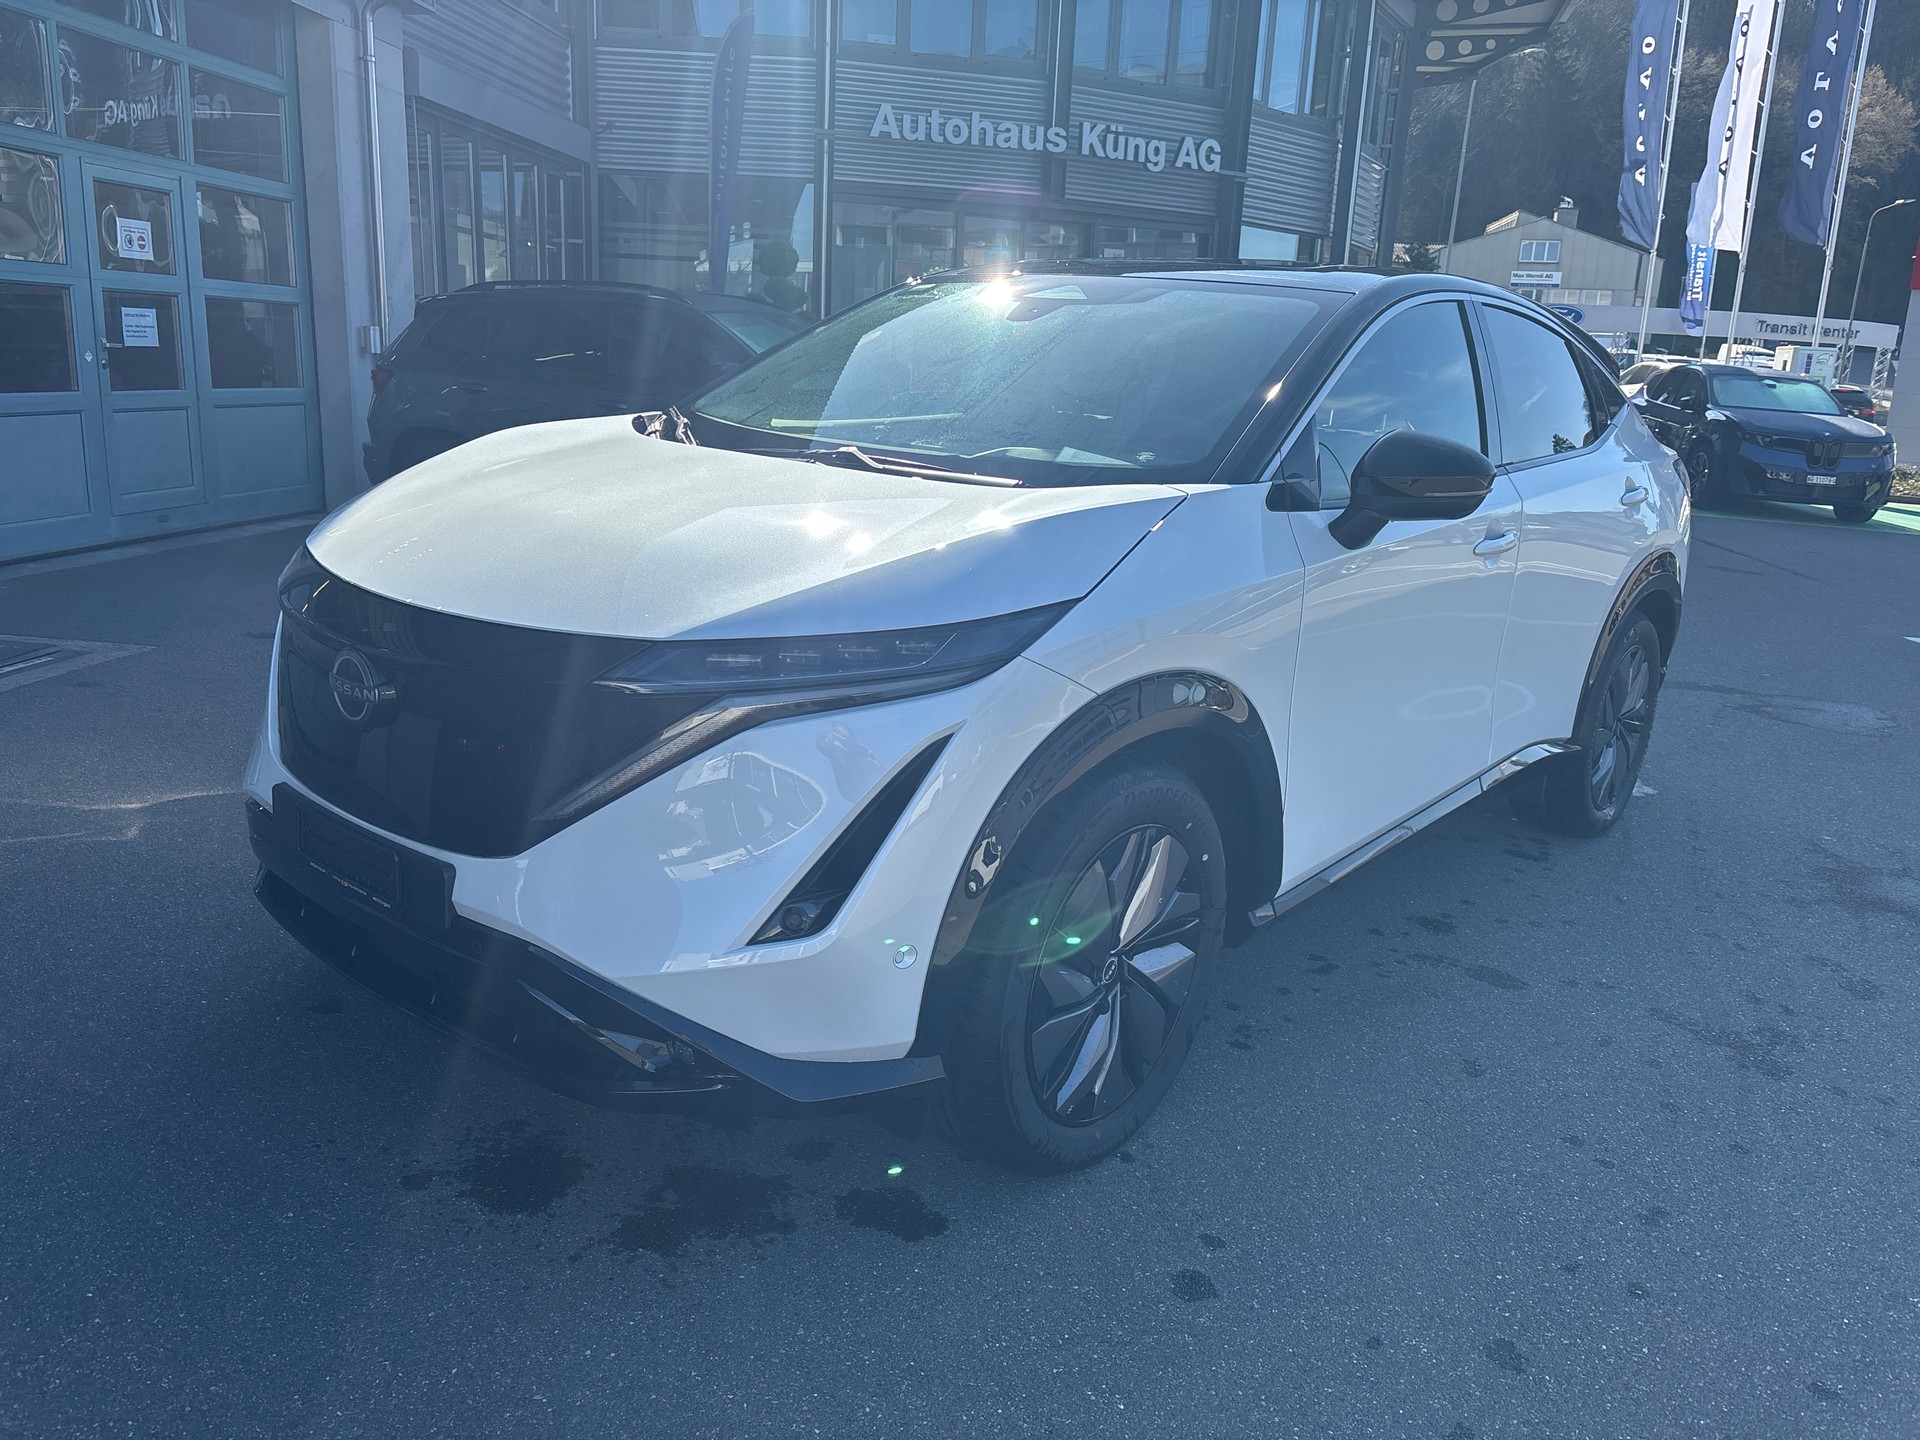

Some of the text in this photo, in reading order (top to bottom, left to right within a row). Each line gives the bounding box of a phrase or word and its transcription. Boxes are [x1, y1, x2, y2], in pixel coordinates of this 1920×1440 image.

[868, 103, 1222, 174] Autohaus Küng AG
[1757, 319, 1808, 336] Transit
